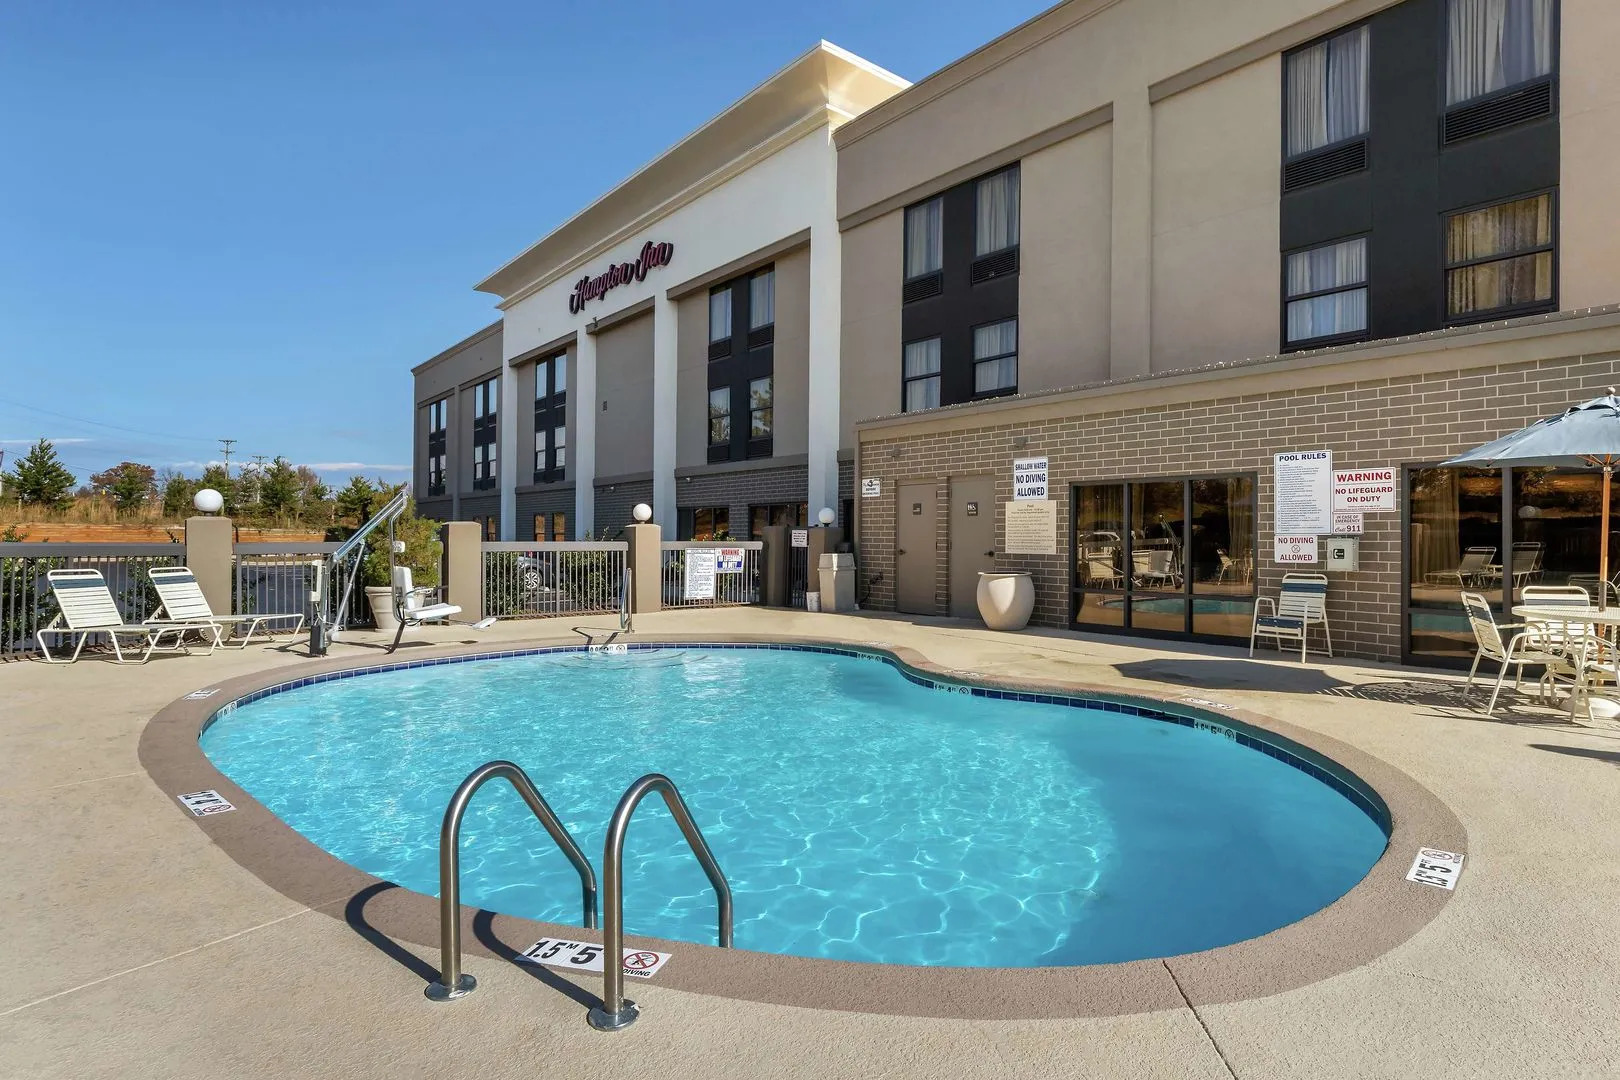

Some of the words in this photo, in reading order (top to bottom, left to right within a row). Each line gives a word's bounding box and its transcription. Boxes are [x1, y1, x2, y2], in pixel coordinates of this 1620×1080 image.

[569, 264, 634, 314] Hampton
[635, 241, 674, 282] Inn
[1301, 452, 1327, 460] RULES
[1034, 461, 1047, 469] WATER
[1016, 474, 1025, 484] NO
[1025, 473, 1046, 483] DIVING
[1336, 471, 1392, 482] WARNING
[1017, 487, 1045, 496] ALLOWED
[1348, 486, 1393, 494] LIFEGUARD
[623, 968, 651, 976] DIVING
